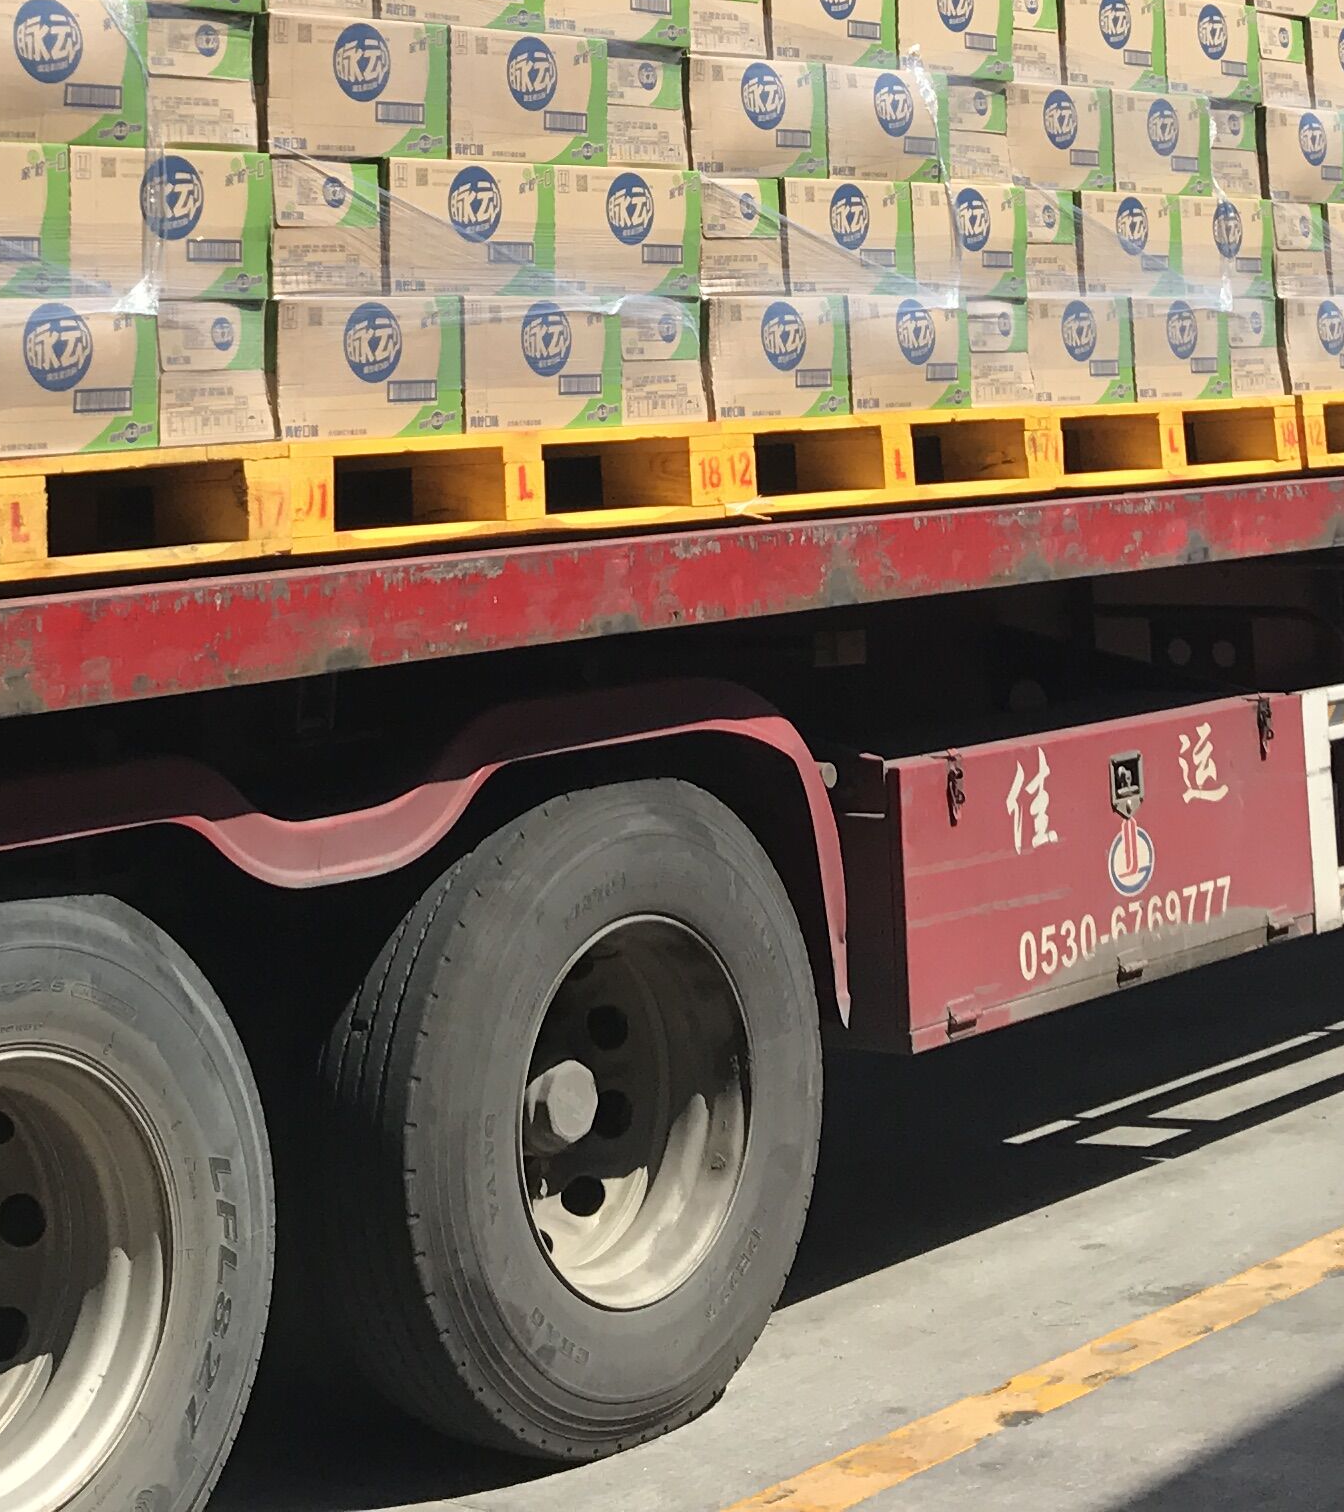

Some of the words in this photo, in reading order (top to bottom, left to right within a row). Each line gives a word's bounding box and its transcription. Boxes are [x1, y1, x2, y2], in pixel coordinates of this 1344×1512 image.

[15, 14, 80, 66] 脉动
[142, 172, 202, 222] 脉动
[24, 320, 89, 372] 脉动
[518, 464, 533, 500] L
[698, 457, 722, 488] 18
[728, 451, 753, 486] 12
[10, 501, 27, 542] L
[1006, 747, 1058, 855] 佳
[1178, 722, 1229, 805] 运
[1019, 875, 1231, 981] 0530-6769777
[184, 1155, 239, 1438] LFL827
